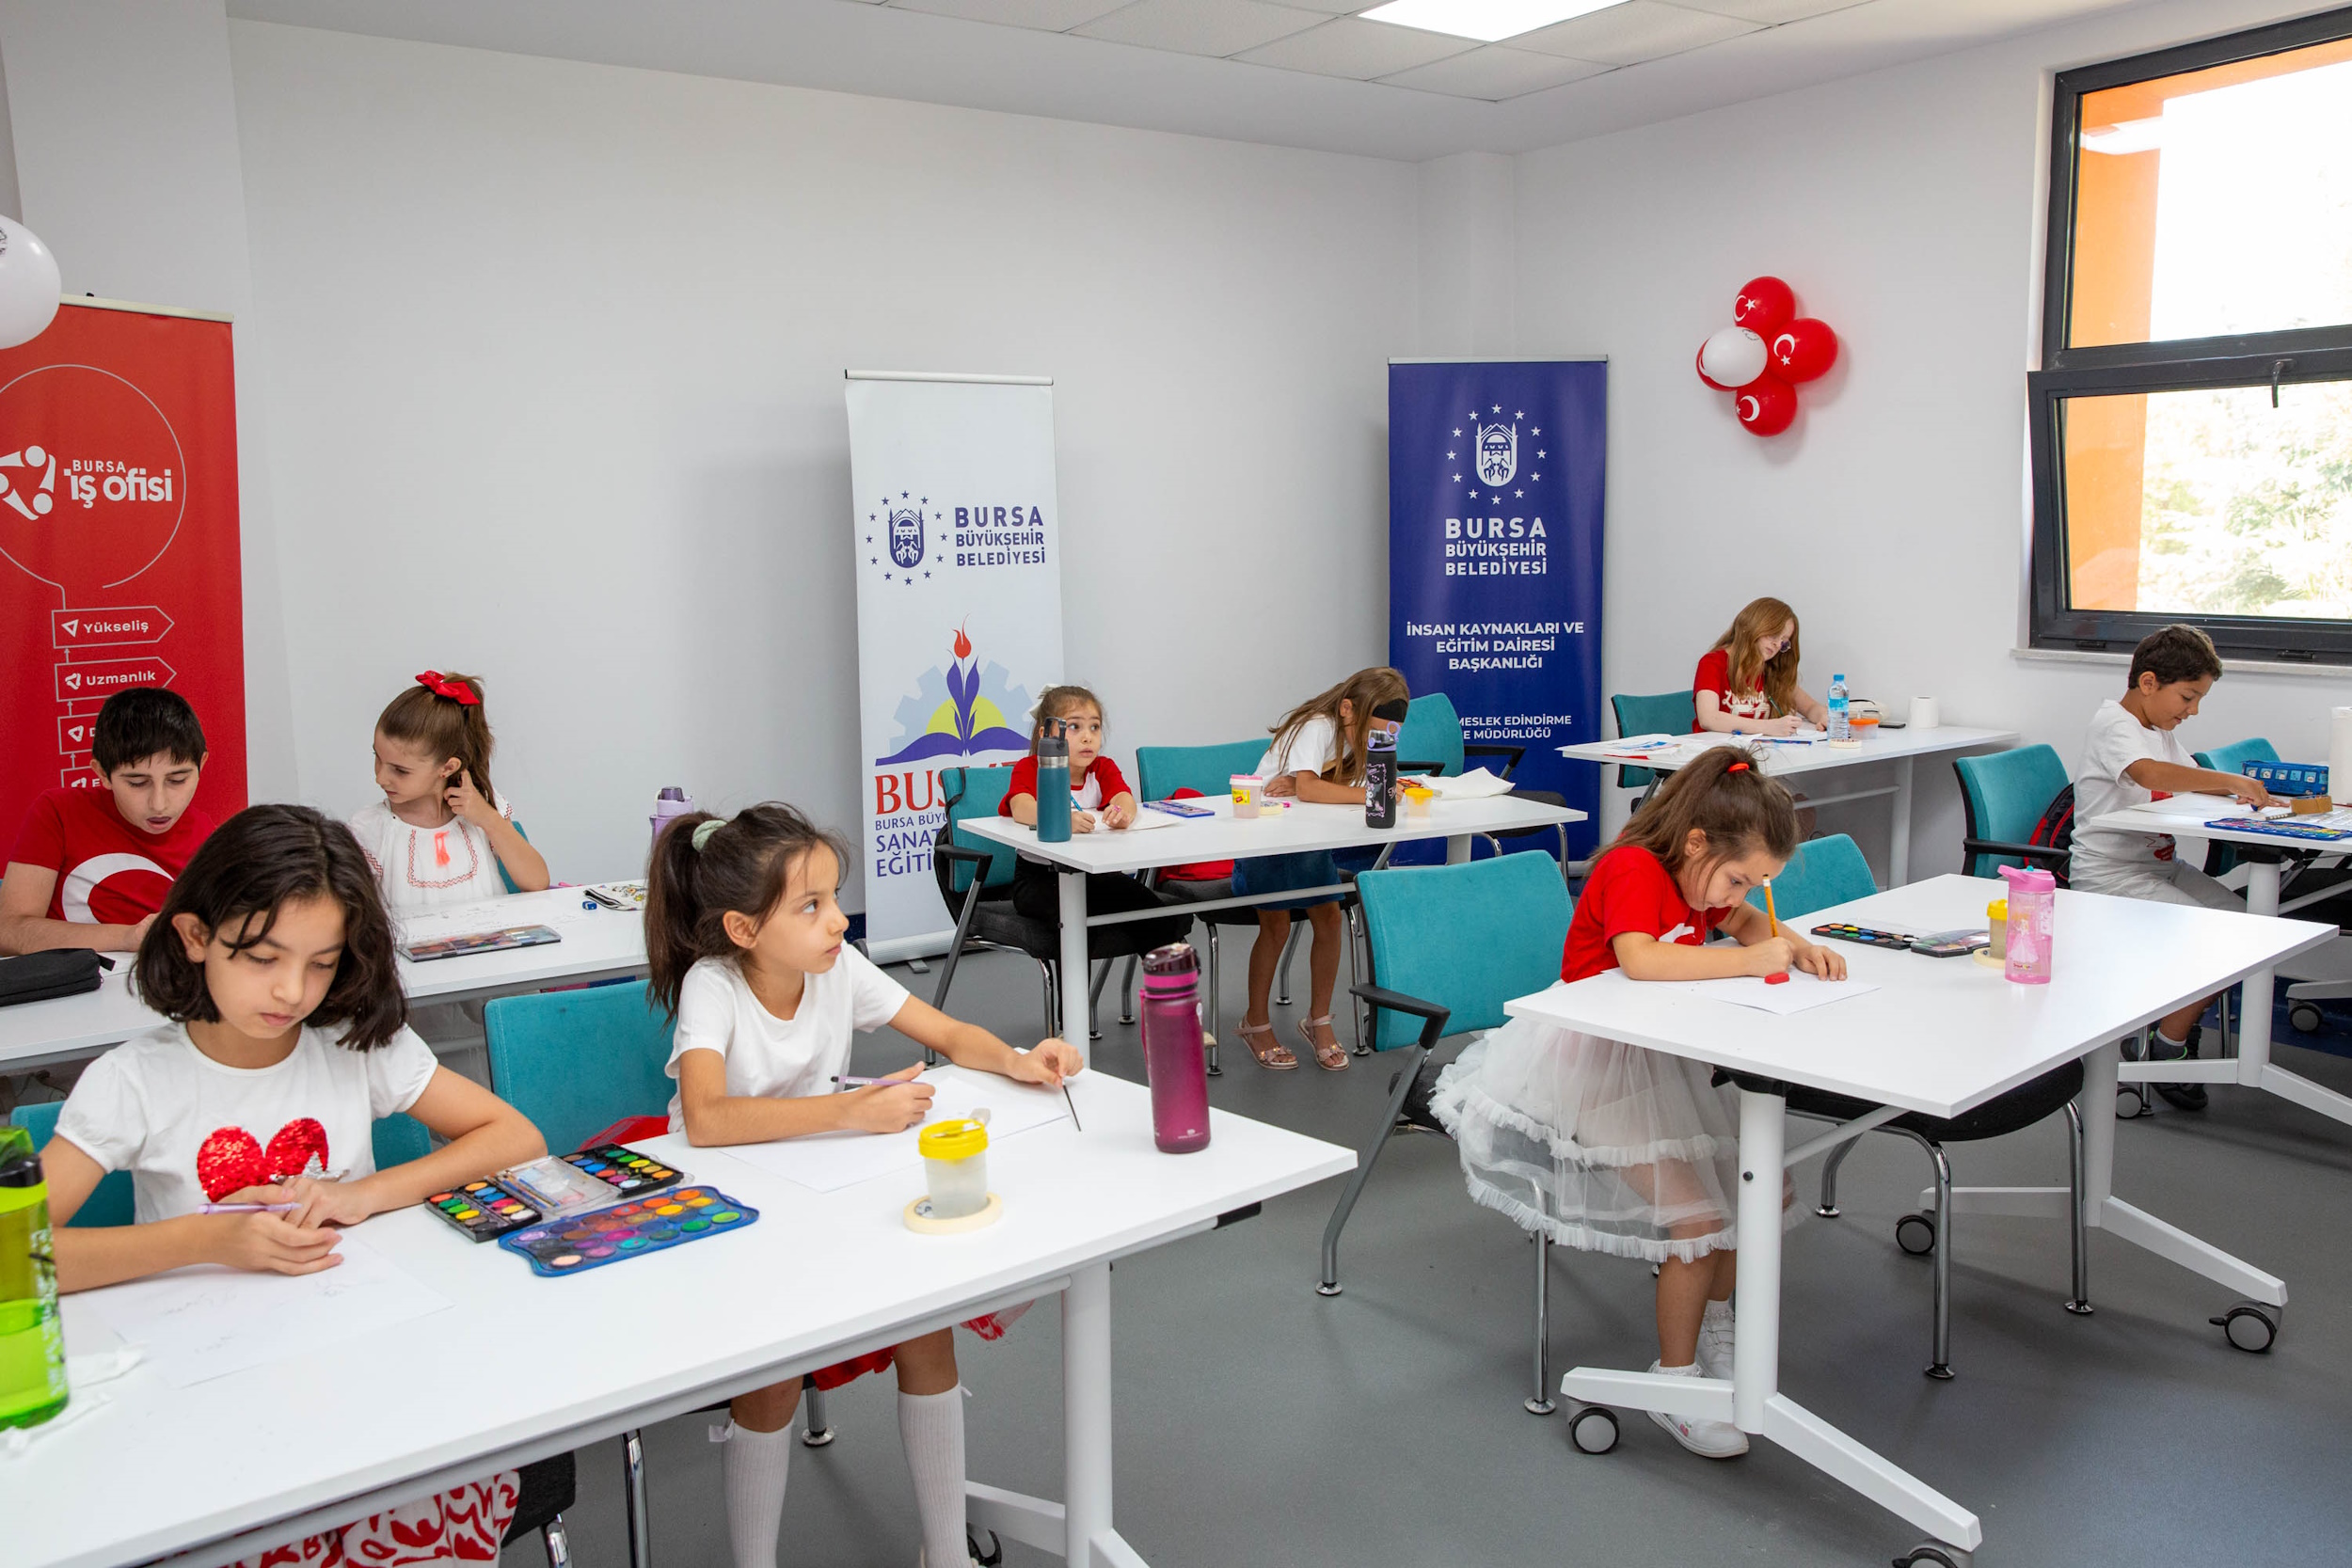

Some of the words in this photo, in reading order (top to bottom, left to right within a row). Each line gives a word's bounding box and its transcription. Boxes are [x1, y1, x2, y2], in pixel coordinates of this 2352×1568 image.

[72, 459, 126, 473] BURSA
[64, 468, 97, 509] iş
[103, 467, 172, 502] ofisi
[955, 506, 1043, 528] BURSA
[1445, 516, 1547, 539] BURSA
[956, 528, 1044, 548] BÜYÜKŞEHİR
[957, 546, 1045, 566] BELEDİYESİ
[1445, 538, 1547, 558] BÜYÜKŞEHİR
[1445, 557, 1547, 576] BELEDİYESİ
[84, 621, 149, 634] Yükseliş
[1406, 621, 1455, 636] İNSAN
[1460, 623, 1559, 636] KAYNAKLARI
[1564, 622, 1584, 634] VE
[1437, 637, 1489, 653] EĞİTİM
[1493, 636, 1555, 652] DAİRESİ
[1449, 654, 1543, 673] BAŞKANLIĞI
[87, 671, 156, 686] Uzmanlık
[1504, 714, 1572, 725] EDİNDİRME
[1474, 727, 1550, 739] MÜDÜRLÜĞÜ
[875, 816, 914, 831] BURSA
[877, 848, 932, 878] EĞİTİ
